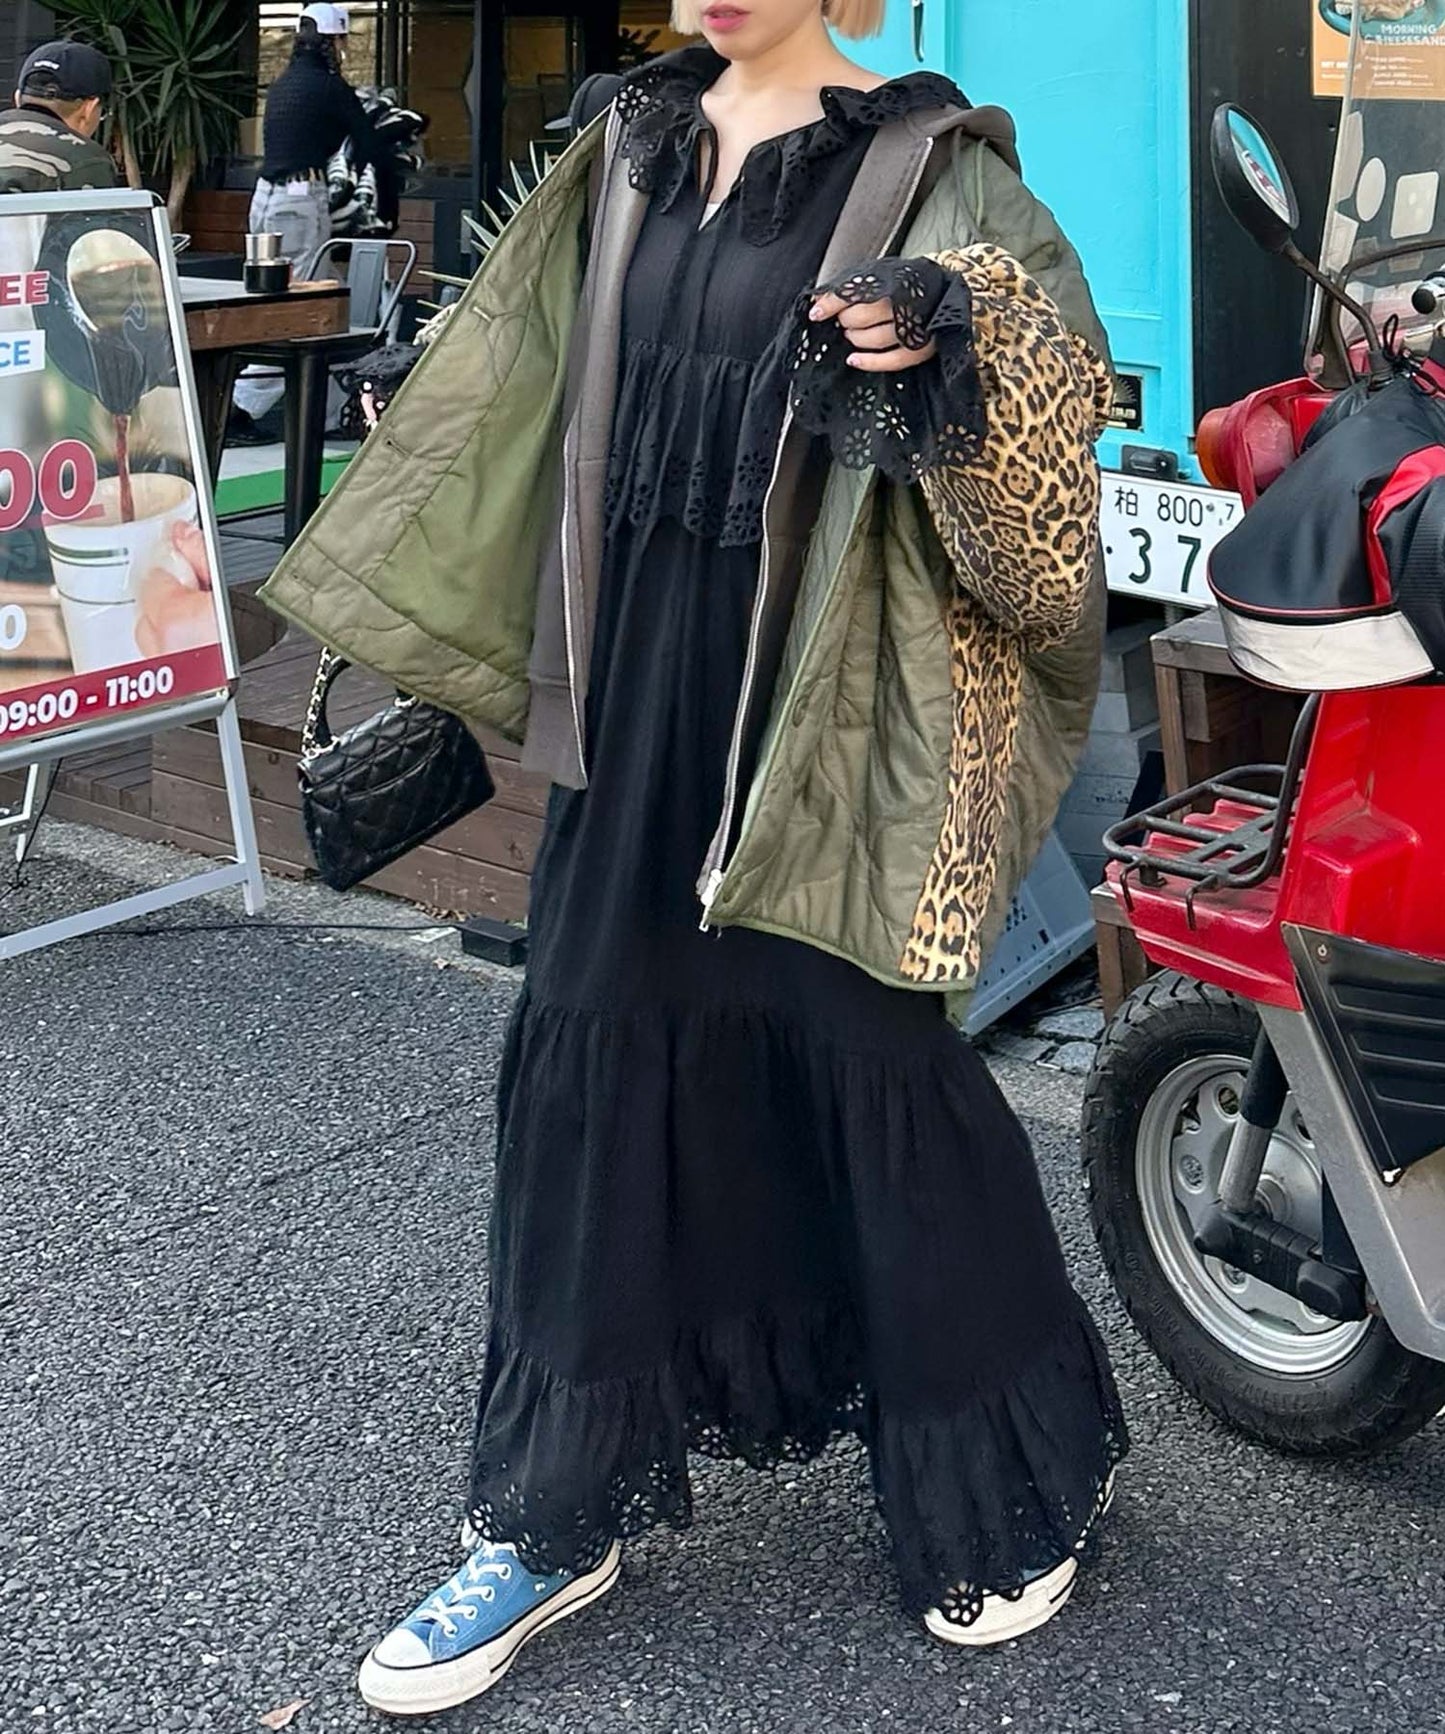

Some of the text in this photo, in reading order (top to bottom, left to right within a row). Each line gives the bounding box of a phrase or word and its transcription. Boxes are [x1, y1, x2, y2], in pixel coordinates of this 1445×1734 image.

[1381, 24, 1437, 34] MORNING
[1115, 486, 1203, 527] 柏 800
[105, 665, 174, 707] 11:00
